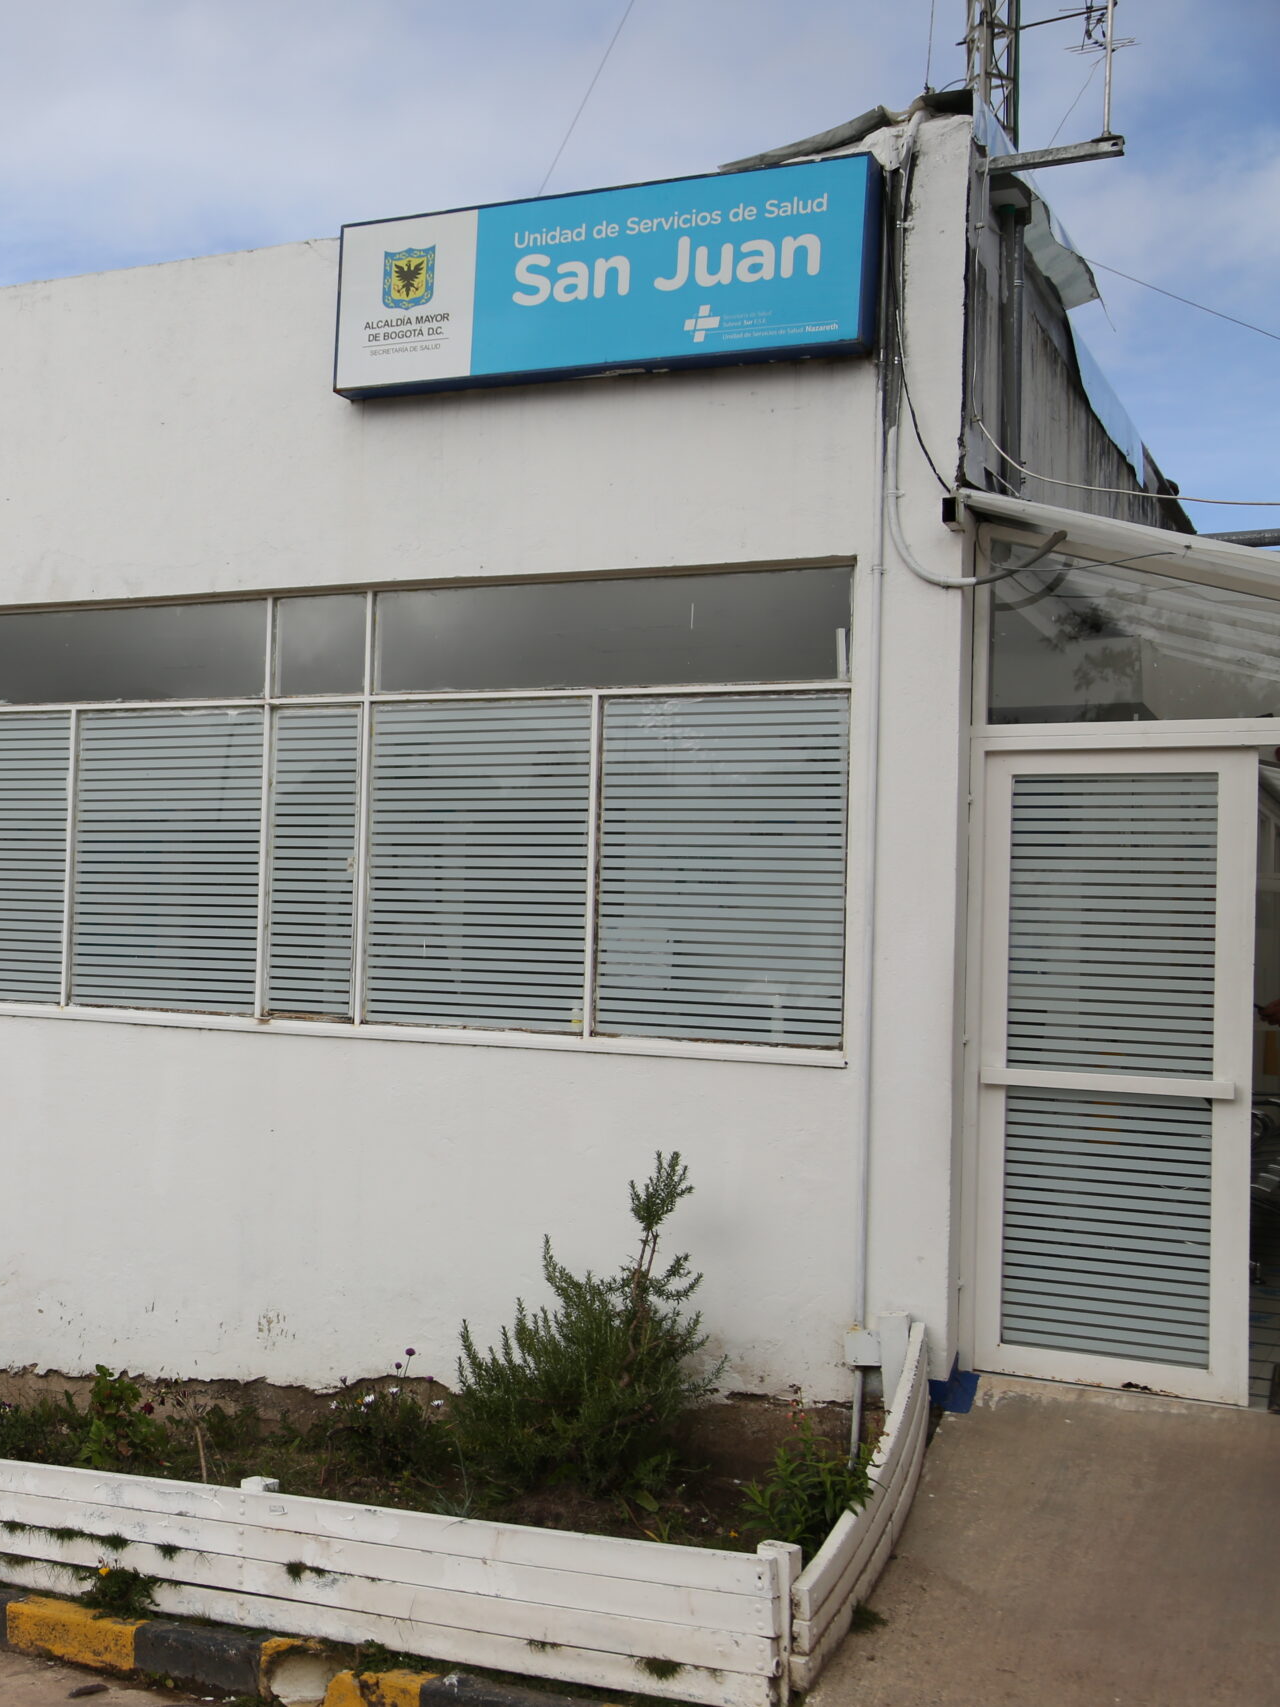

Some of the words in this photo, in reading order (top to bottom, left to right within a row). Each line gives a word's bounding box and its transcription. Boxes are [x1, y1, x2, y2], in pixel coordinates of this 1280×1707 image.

[514, 223, 586, 249] Unidad
[593, 220, 619, 240] de
[625, 208, 721, 235] Servicios
[728, 203, 757, 223] de
[764, 192, 828, 218] Salud
[512, 253, 631, 306] San
[653, 233, 822, 292] Juan
[364, 316, 412, 330] ALCALDÍA
[415, 313, 450, 324] MAYOR
[806, 323, 838, 333] Nazareth
[368, 332, 381, 342] DE
[383, 328, 424, 341] BOGOTÁ
[420, 343, 441, 351] SALUD
